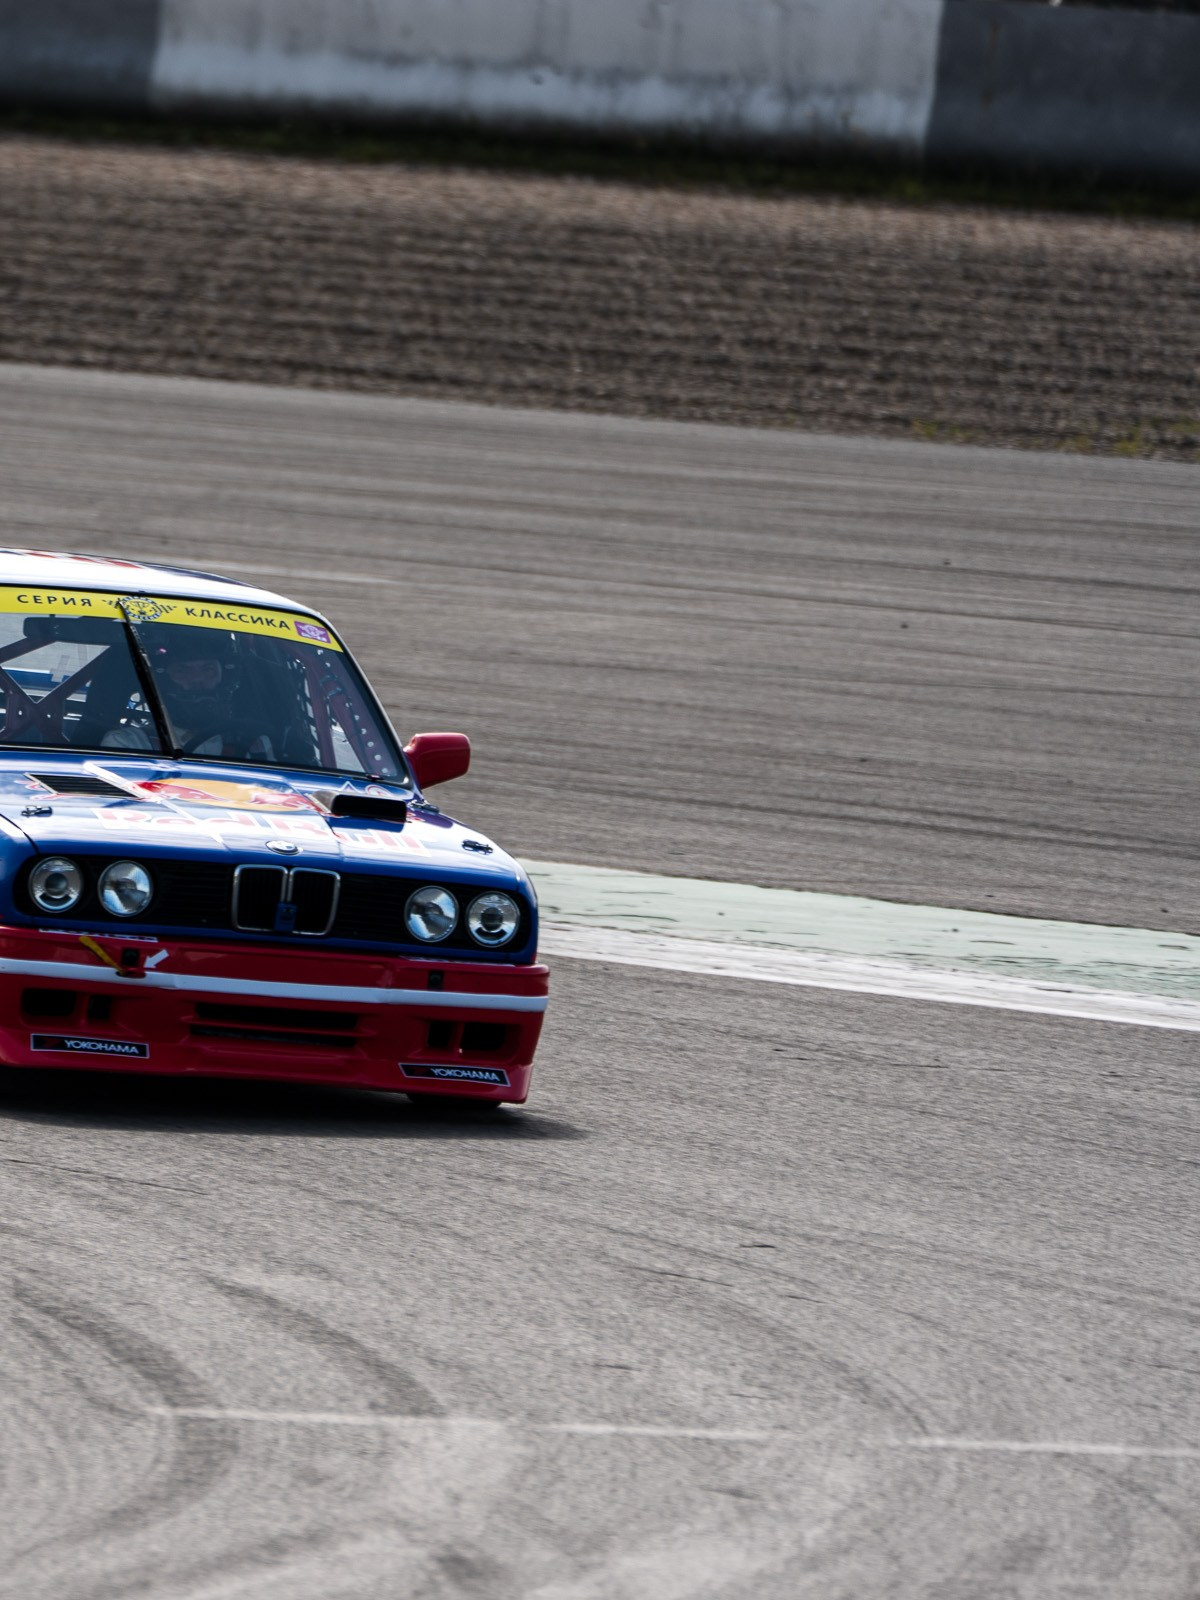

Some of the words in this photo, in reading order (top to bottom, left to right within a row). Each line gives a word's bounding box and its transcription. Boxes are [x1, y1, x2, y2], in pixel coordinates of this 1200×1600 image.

[17, 594, 92, 607] СЕРИЯ
[185, 607, 291, 630] КЛАССИКА
[64, 1039, 139, 1054] YOKOHAMA
[431, 1067, 500, 1081] YOKOHAMA
